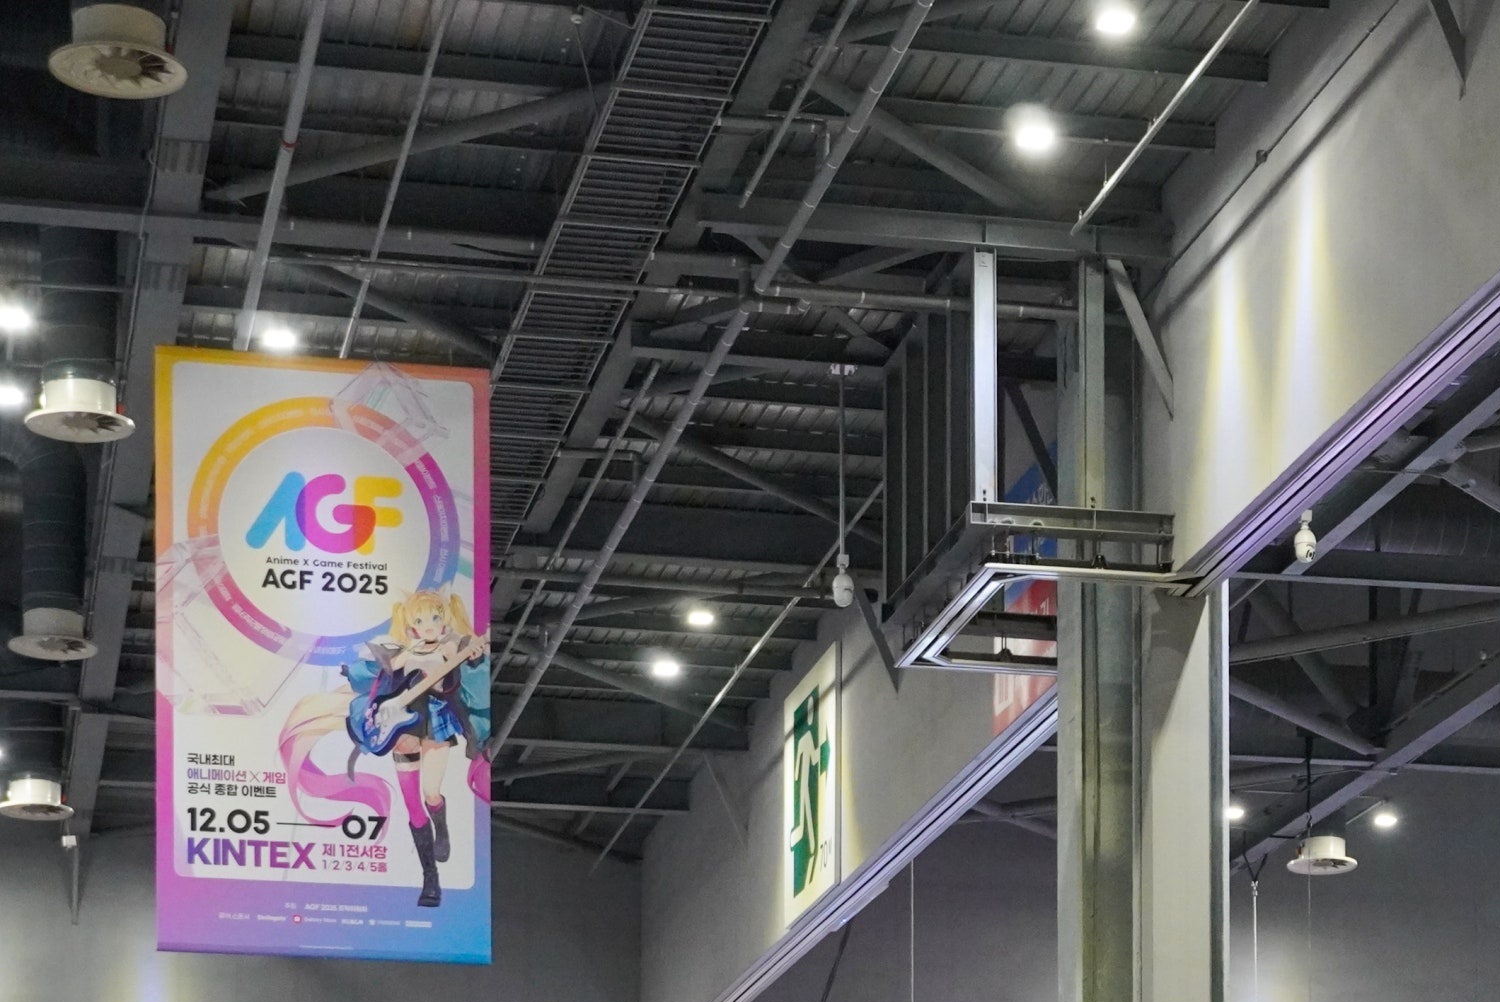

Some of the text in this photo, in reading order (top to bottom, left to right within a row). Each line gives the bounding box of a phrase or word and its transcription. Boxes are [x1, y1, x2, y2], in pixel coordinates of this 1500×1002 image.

[245, 471, 404, 556] AGF
[266, 556, 300, 566] Anime
[312, 559, 344, 568] Game
[347, 560, 388, 571] Festival
[262, 568, 389, 595] AGF 2025
[187, 752, 235, 766] 국내최대
[187, 768, 247, 783] 애니메이션
[263, 771, 286, 785] 게임
[187, 783, 277, 798] 공식 종합 이벤트
[187, 807, 388, 841] 12.05 07
[187, 837, 316, 870] KINTEX
